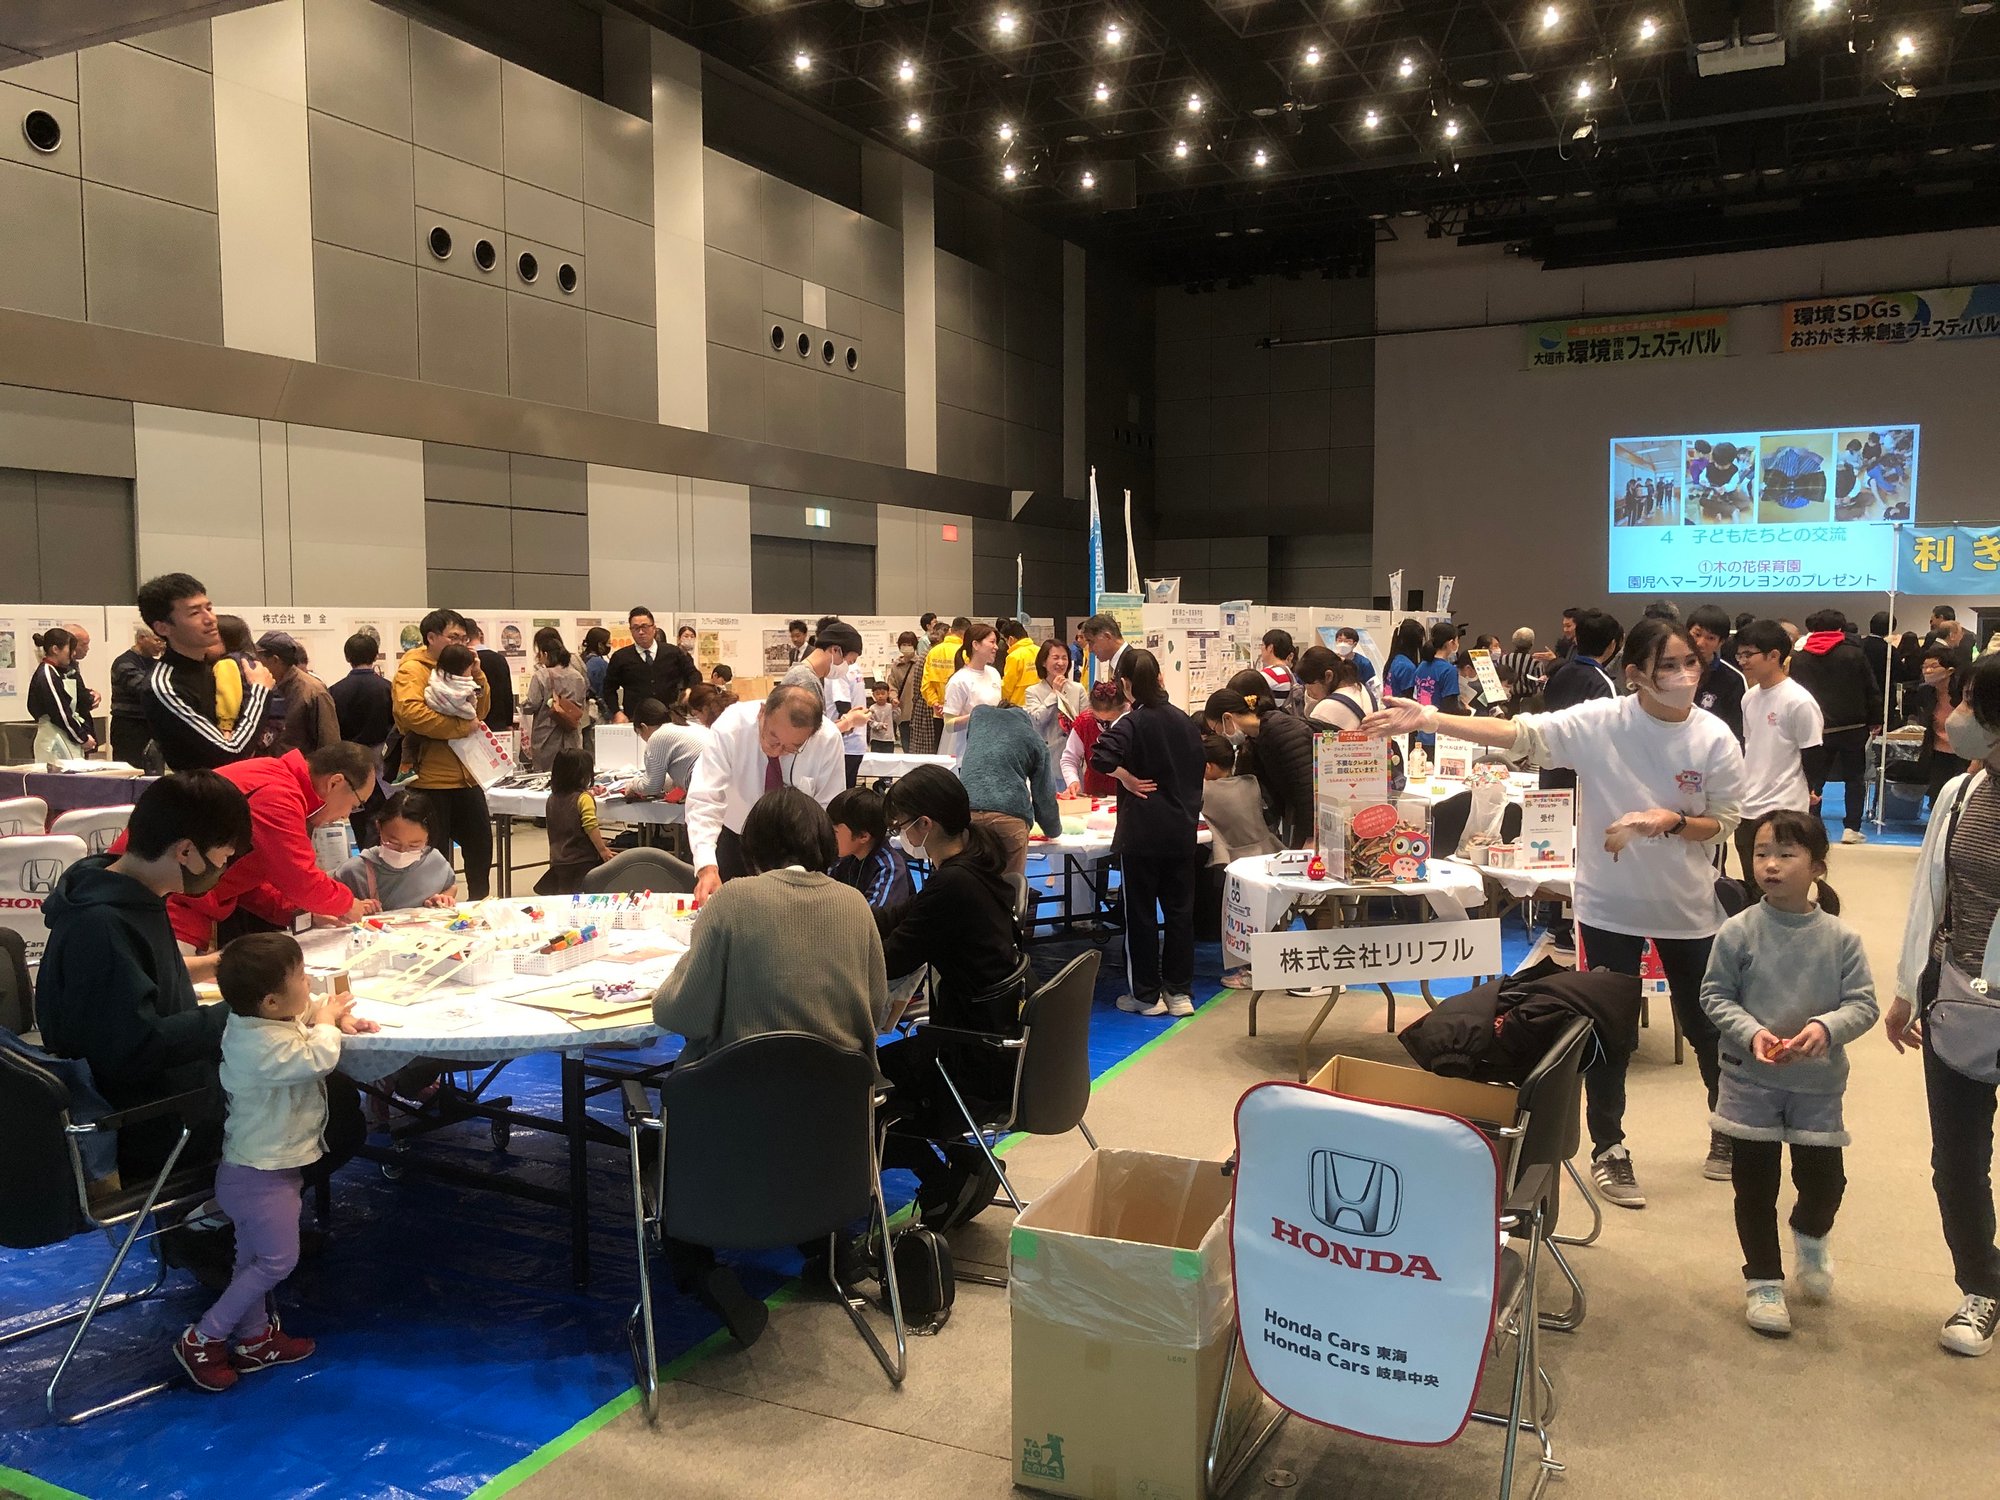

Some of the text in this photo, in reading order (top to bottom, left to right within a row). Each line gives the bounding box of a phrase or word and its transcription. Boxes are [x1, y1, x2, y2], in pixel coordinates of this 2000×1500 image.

[1793, 301, 1900, 326] 環境SDGs
[1790, 315, 2000, 348] おおがき未来創造フェスティバル
[1692, 526, 1848, 545] 子どもたちとの交流
[263, 614, 296, 624] 株式会社
[1540, 814, 1555, 823] 受付
[1280, 937, 1474, 974] 株式会社リリフル
[1271, 1217, 1442, 1281] HONDA
[1264, 1308, 1407, 1363] Honda Cars 東海
[1263, 1328, 1440, 1388] Honda Cars 岐阜中央
